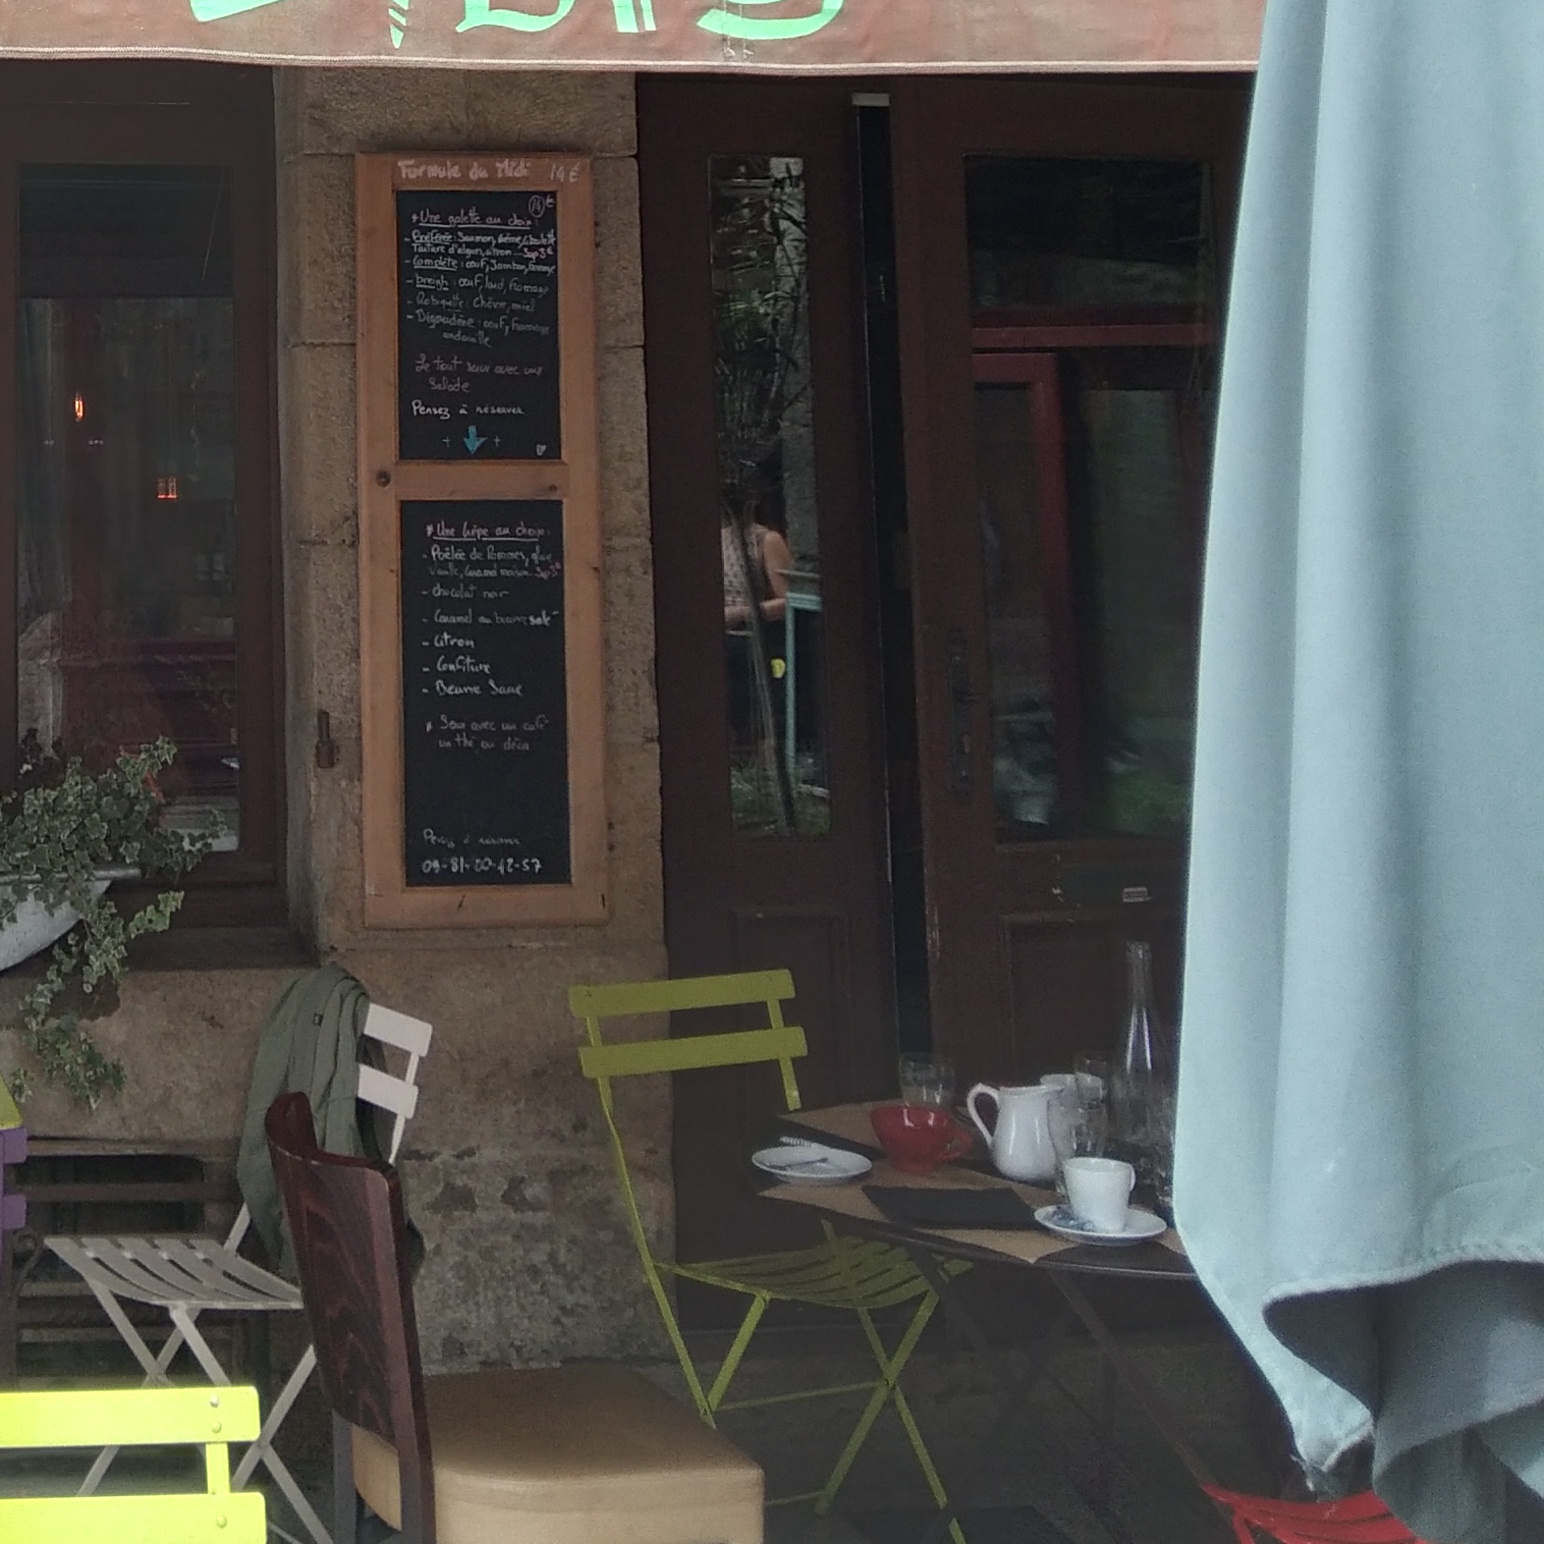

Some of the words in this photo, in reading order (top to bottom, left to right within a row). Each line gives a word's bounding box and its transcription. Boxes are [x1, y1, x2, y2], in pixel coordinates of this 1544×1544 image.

[397, 159, 462, 179] Formule
[469, 161, 489, 180] du
[495, 158, 531, 179] Midi
[420, 208, 442, 224] Une
[447, 206, 483, 228] galette
[485, 214, 502, 224] au
[493, 365, 520, 375] avec
[411, 399, 451, 420] Pensez
[436, 521, 456, 536] Une
[495, 526, 511, 536] au
[469, 547, 485, 561] de
[471, 721, 497, 731] avec
[501, 722, 517, 731] un
[438, 739, 452, 748] un
